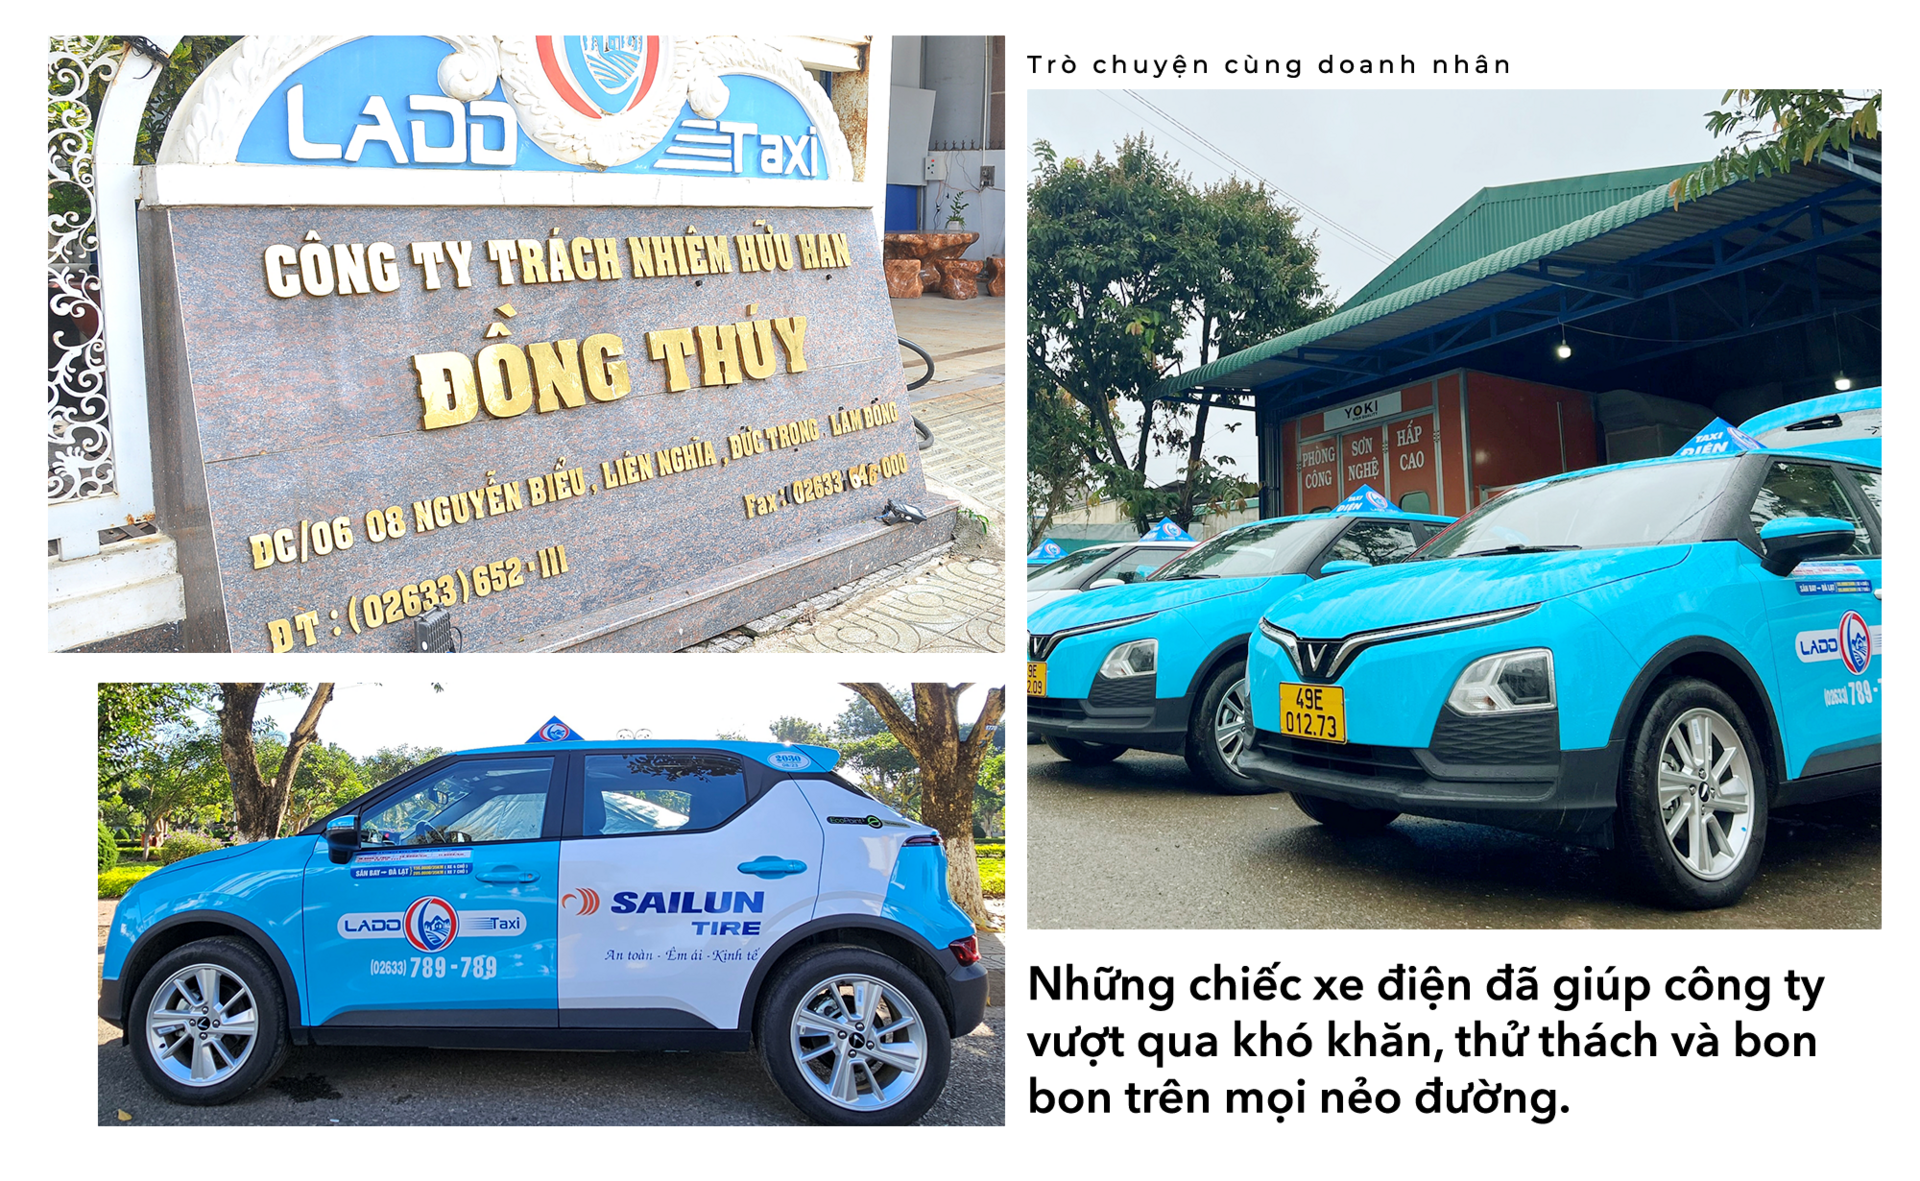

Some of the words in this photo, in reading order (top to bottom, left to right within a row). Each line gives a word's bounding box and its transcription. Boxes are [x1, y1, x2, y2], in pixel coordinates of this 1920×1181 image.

[715, 120, 818, 178] Taxi
[264, 229, 400, 299] CÔNG
[410, 239, 473, 290] TY
[487, 226, 623, 286] TRÁCH
[411, 302, 631, 430] ĐỒNG
[644, 303, 808, 393] THÚY
[1344, 400, 1378, 419] YOKI
[1302, 446, 1336, 468] PHÒNG
[1351, 436, 1373, 456] SƠN
[1396, 419, 1422, 447] HẤP
[1695, 431, 1724, 443] TAXI
[1305, 469, 1332, 489] CÔNG
[1348, 457, 1380, 480] NGHỆ
[1399, 450, 1425, 471] CAO
[365, 505, 407, 543] 08
[412, 470, 523, 533] NGUYỄN
[600, 451, 654, 489] LIÊN
[1800, 638, 1838, 656] LADO
[1296, 687, 1324, 711] 49E
[1286, 711, 1337, 738] 012.73
[775, 754, 802, 762] 2030
[355, 869, 368, 877] SÂN
[369, 869, 380, 877] BAY
[388, 867, 397, 876] ĐÀ
[398, 867, 409, 877] LẠT
[611, 891, 765, 914] SAILUN
[344, 919, 401, 932] LADO
[489, 916, 520, 930] Taxi
[691, 921, 762, 936] TIRE
[604, 949, 623, 961] An
[627, 949, 653, 961] toàn
[665, 946, 687, 961] Êm
[690, 948, 703, 961] ái
[747, 946, 761, 961] tế
[370, 959, 407, 977] (02633)
